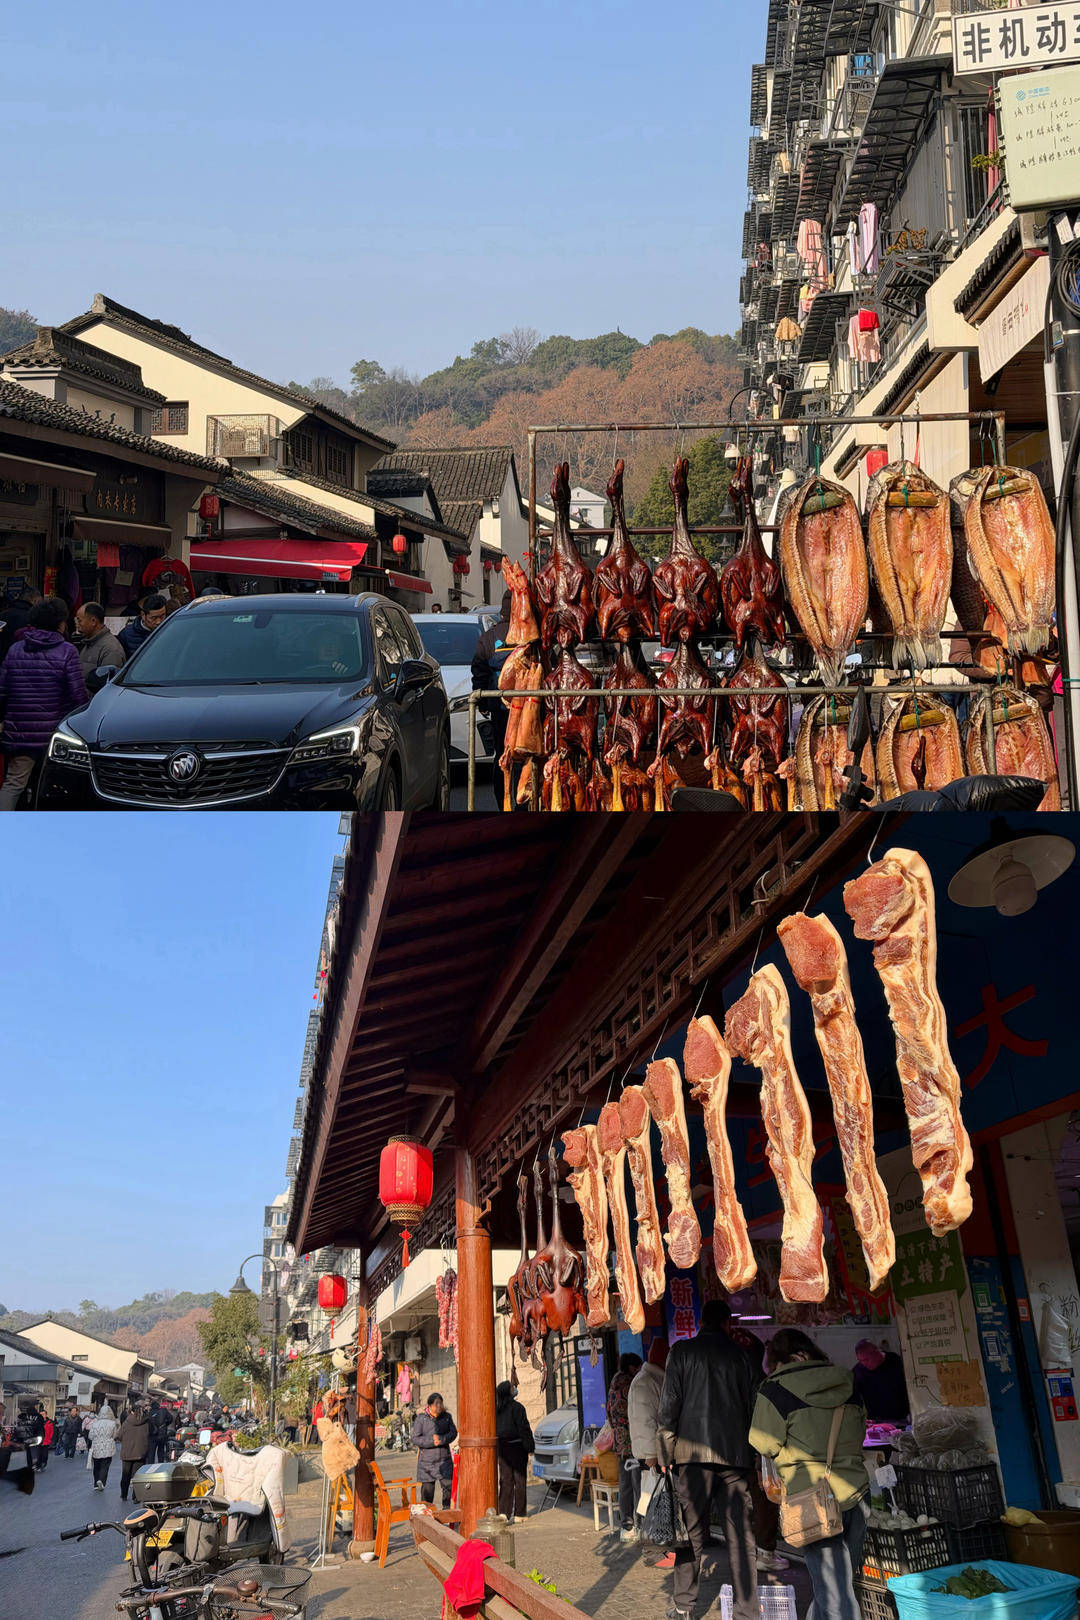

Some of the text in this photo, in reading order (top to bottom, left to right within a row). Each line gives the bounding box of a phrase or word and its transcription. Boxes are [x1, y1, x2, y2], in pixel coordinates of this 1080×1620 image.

[963, 12, 1080, 63] 非机动
[954, 984, 1049, 1089] 大
[900, 1253, 953, 1287] 土特产
[670, 1277, 695, 1339] 新鲜
